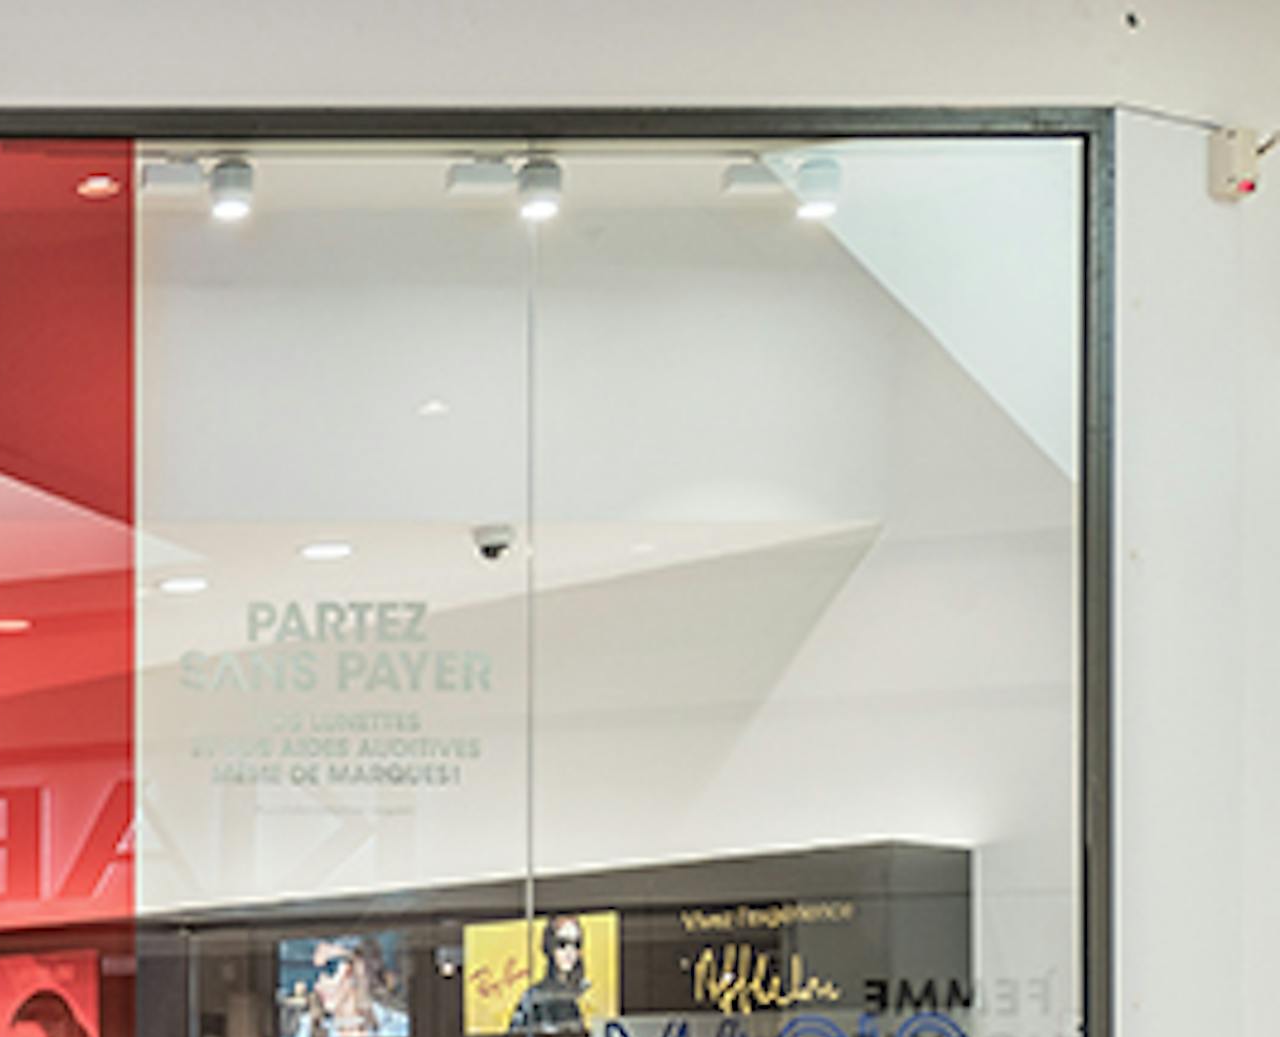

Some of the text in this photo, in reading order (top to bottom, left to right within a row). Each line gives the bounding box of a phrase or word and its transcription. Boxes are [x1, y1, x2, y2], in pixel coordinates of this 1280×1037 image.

[246, 600, 429, 643] PARTEZ
[178, 649, 494, 693] SANS PAYER
[310, 711, 423, 733] LUNETTES
[280, 737, 350, 759] AIDES
[356, 736, 483, 759] AUDITIVES
[290, 762, 321, 785] DE
